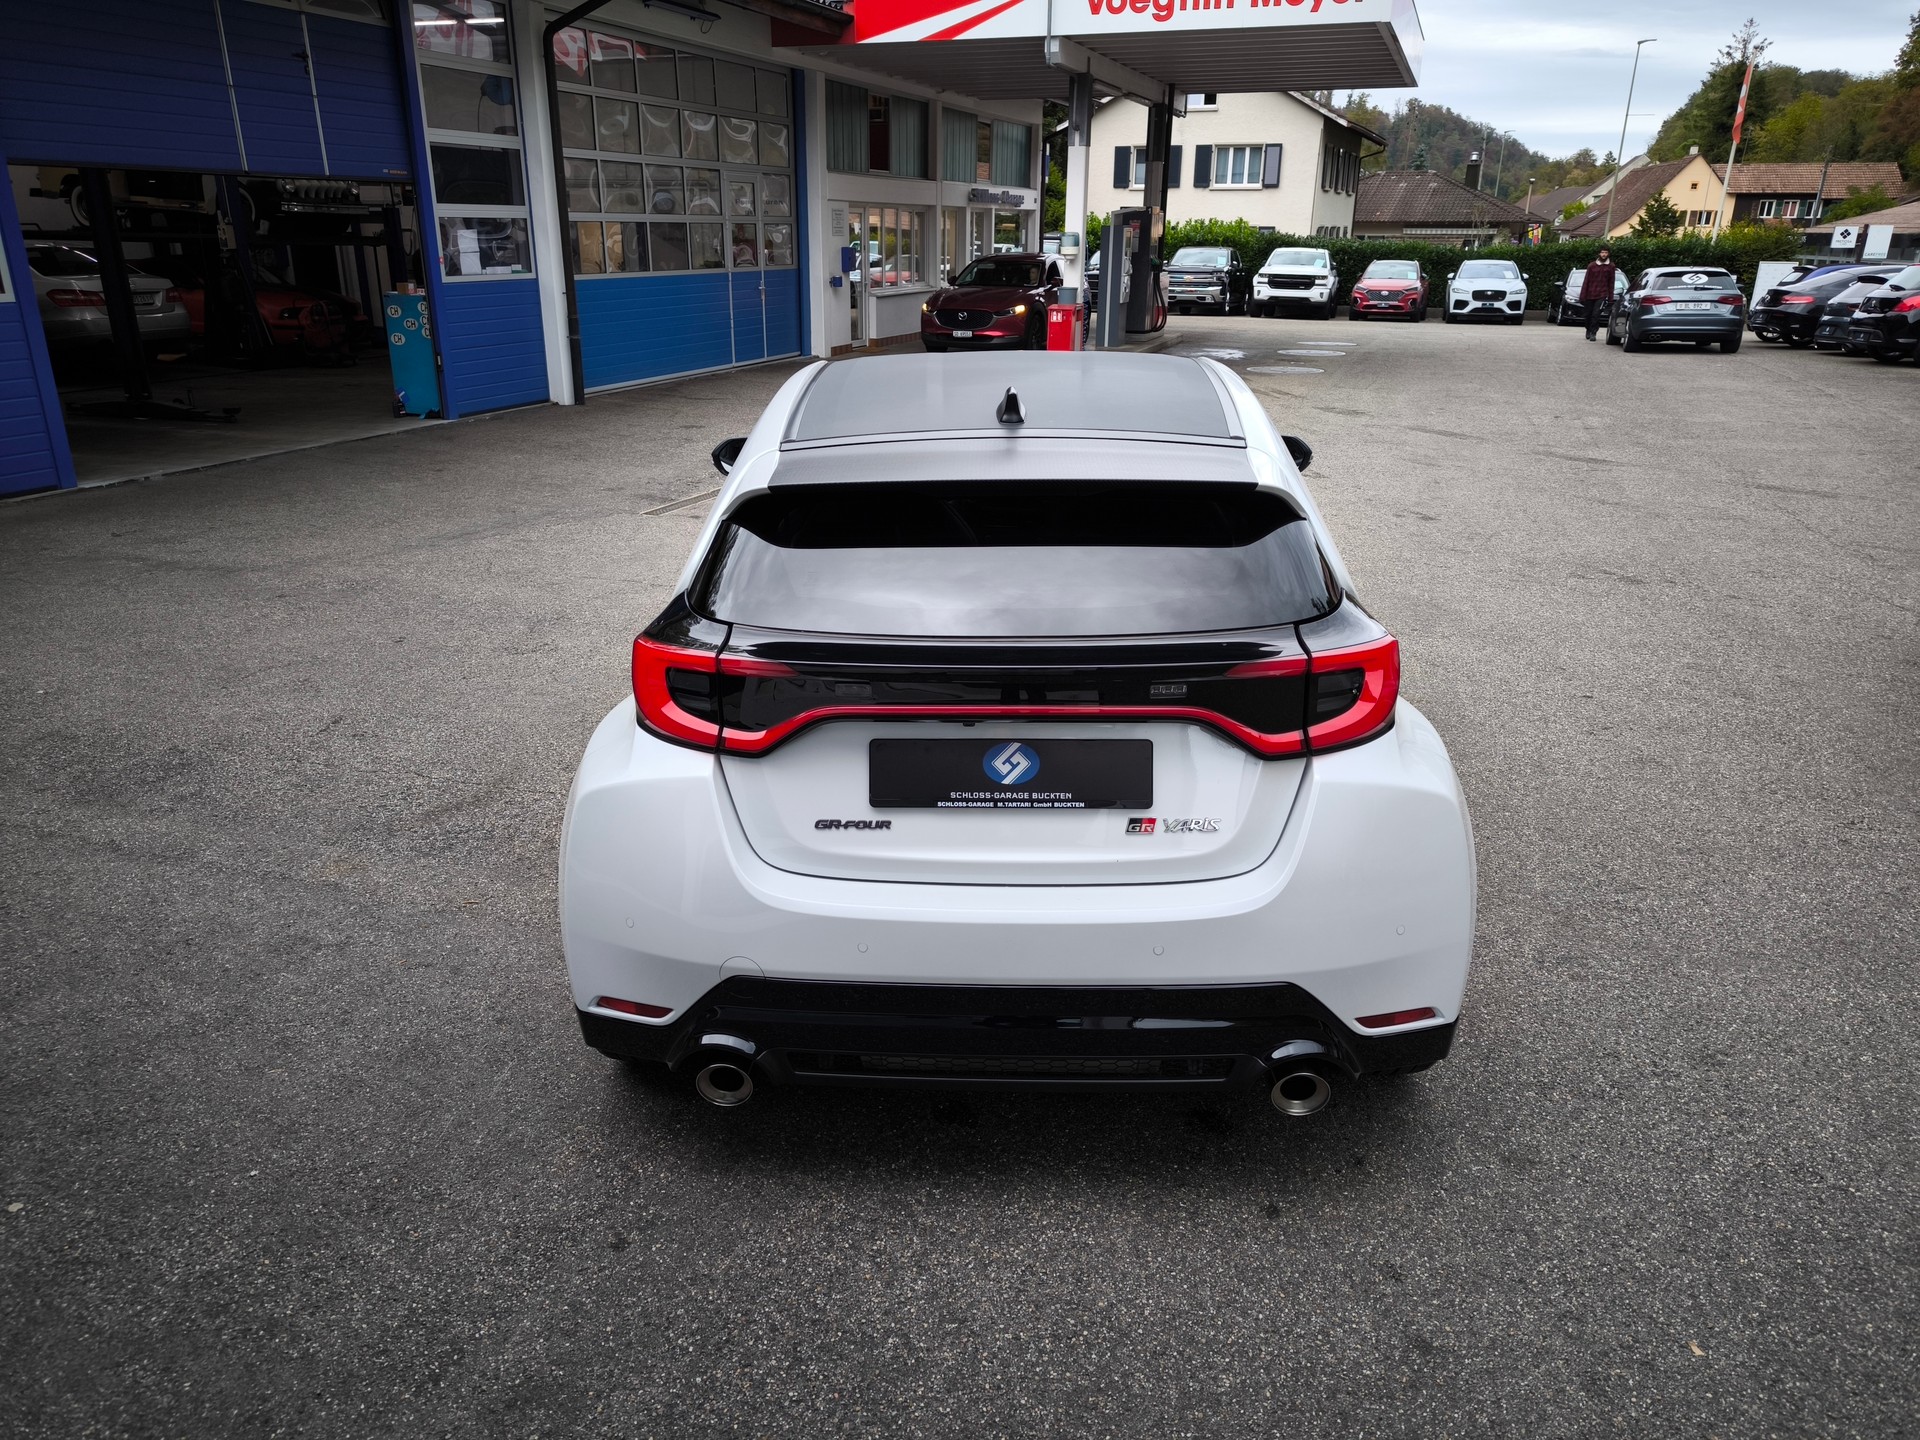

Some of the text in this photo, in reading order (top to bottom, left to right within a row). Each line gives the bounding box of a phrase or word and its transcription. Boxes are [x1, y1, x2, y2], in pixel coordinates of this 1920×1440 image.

[390, 307, 399, 316] CH
[405, 320, 416, 328] CH
[393, 334, 403, 343] CH
[815, 819, 892, 830] GR-FOUR
